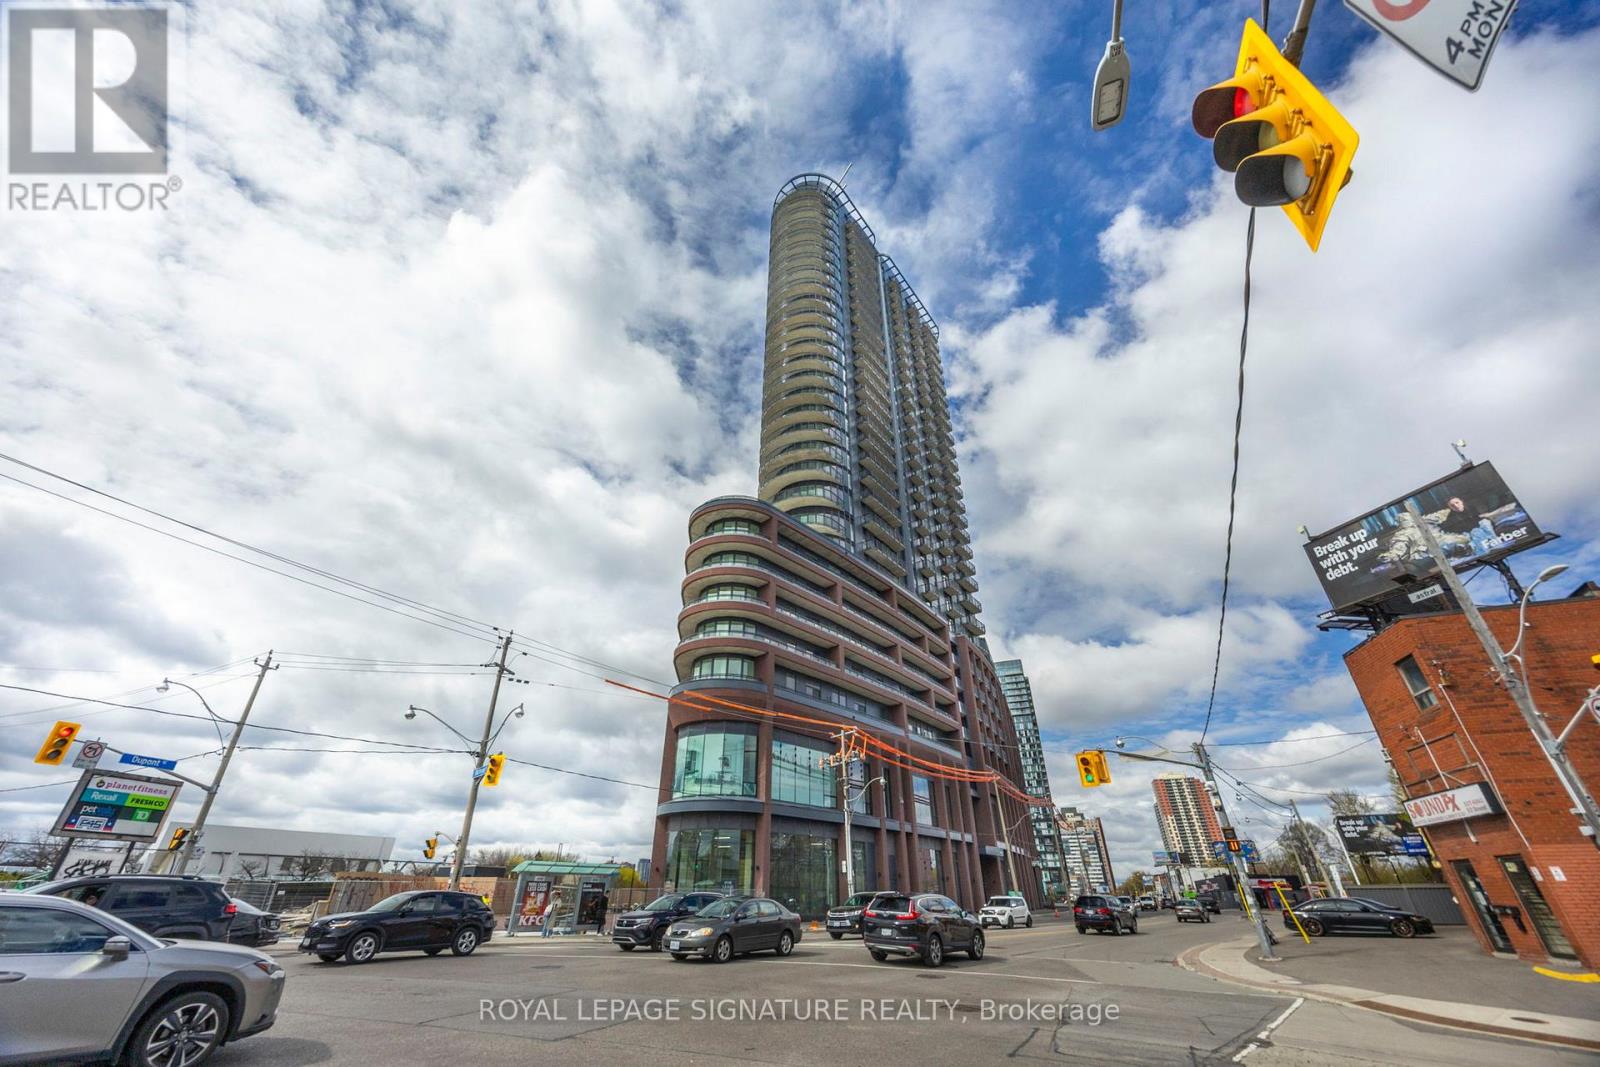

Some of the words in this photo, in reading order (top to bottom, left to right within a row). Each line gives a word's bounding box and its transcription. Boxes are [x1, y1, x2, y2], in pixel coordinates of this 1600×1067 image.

[1446, 36, 1466, 65] 4
[1460, 0, 1486, 37] PM
[1467, 0, 1505, 60] MON
[1313, 535, 1350, 558] Break
[1348, 528, 1368, 542] up
[1482, 525, 1528, 549] Farber
[1319, 549, 1349, 569] with
[1348, 538, 1379, 561] your
[1325, 561, 1359, 581] debt.
[131, 755, 161, 767] Dupont
[91, 791, 119, 801] Rexall
[519, 915, 545, 926] KFC
